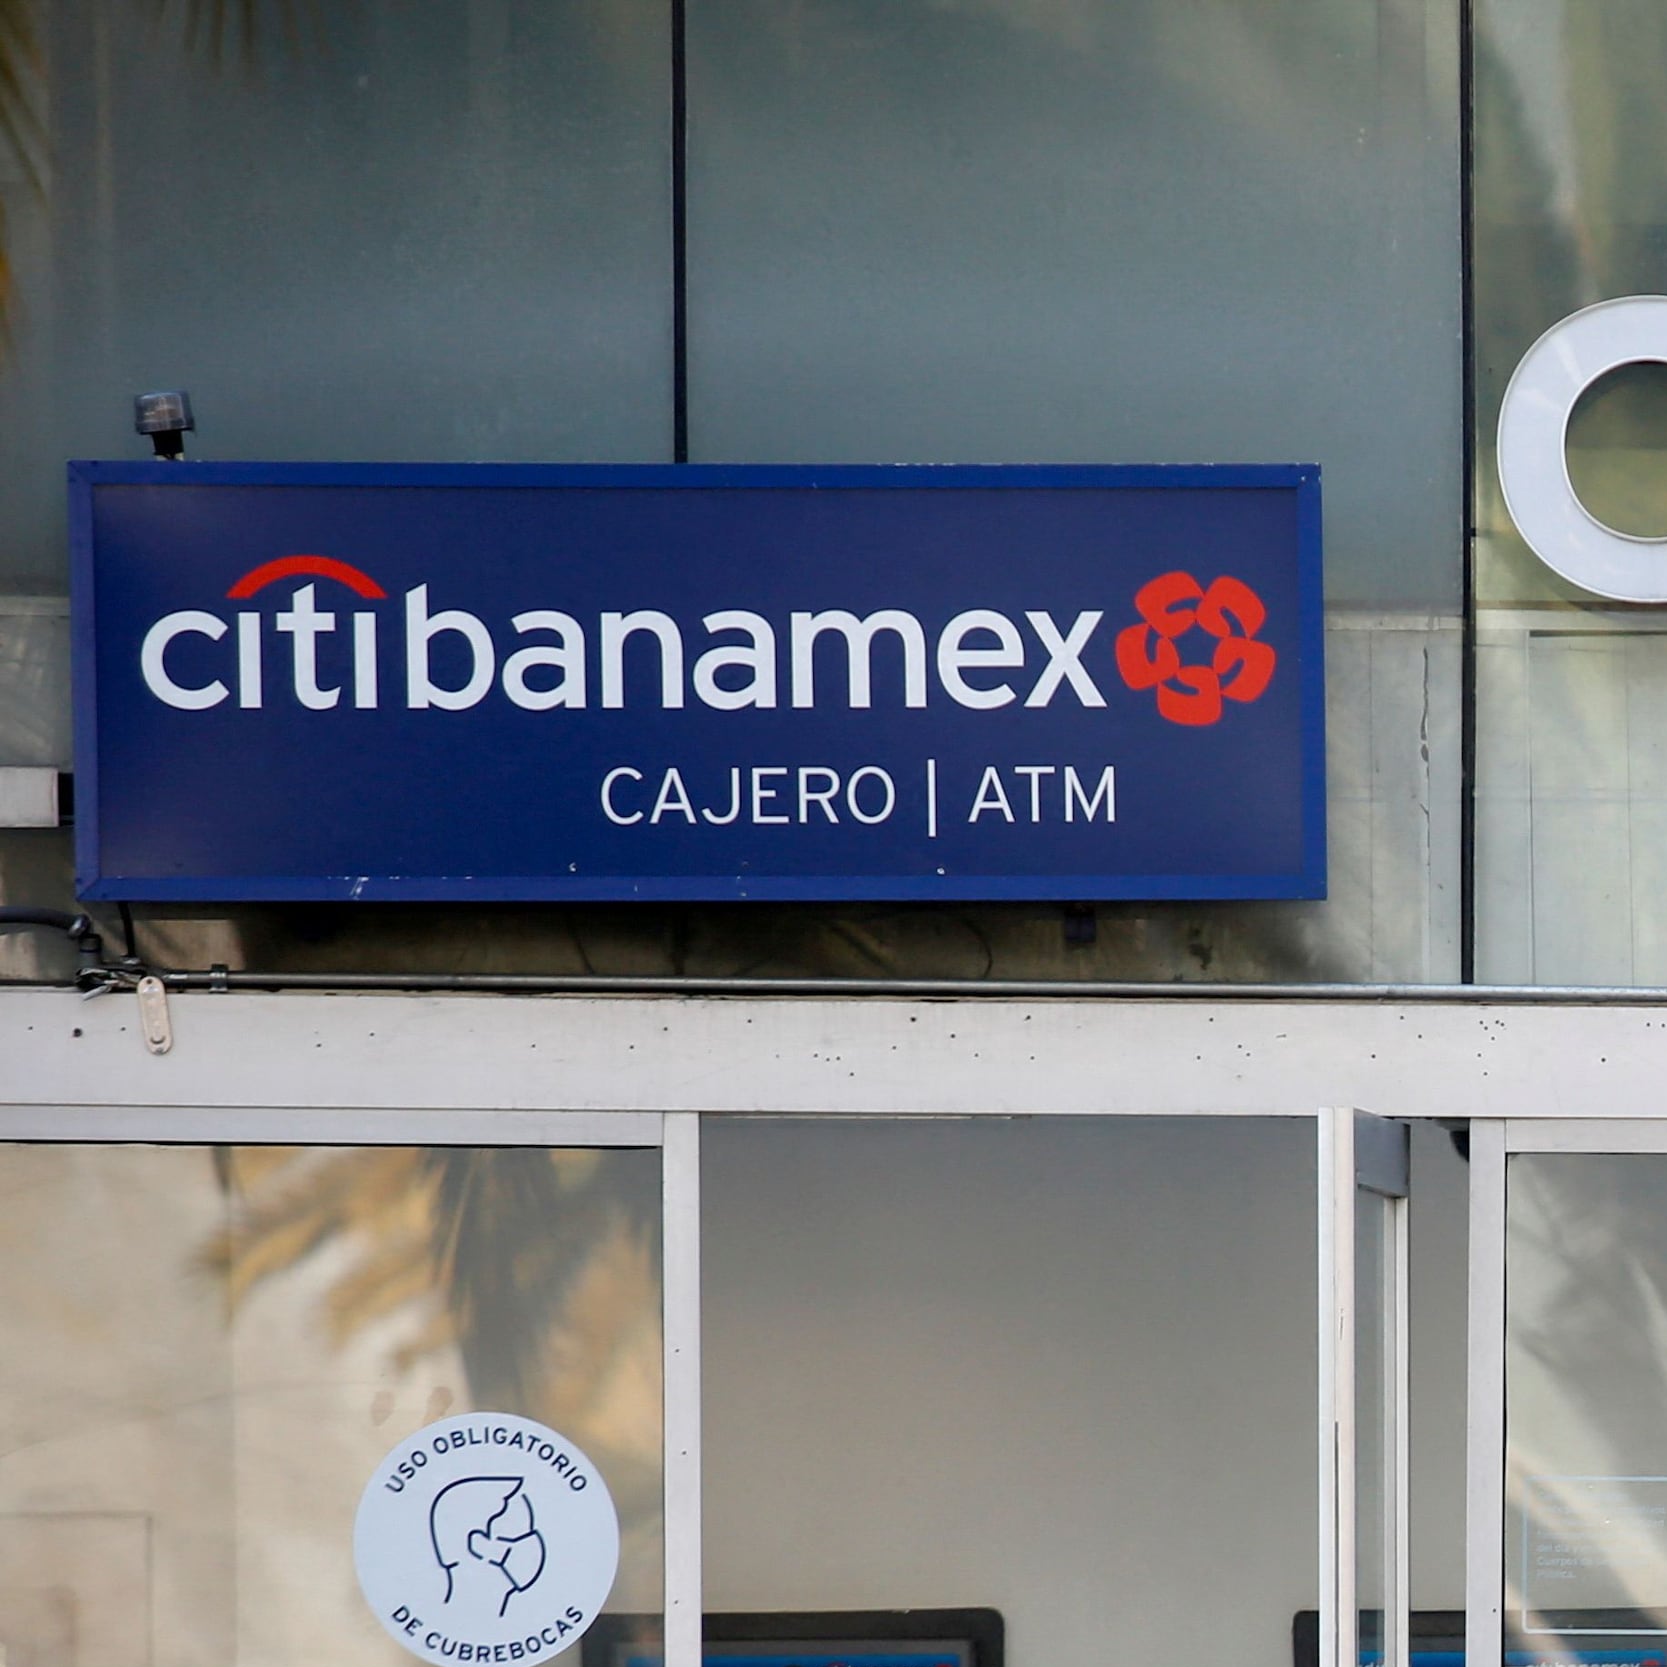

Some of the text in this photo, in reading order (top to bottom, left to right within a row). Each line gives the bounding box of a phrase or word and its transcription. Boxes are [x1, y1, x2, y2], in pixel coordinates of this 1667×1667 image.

[140, 582, 1108, 711] citibanamex
[601, 765, 1118, 827] CAJERO ATM
[385, 1426, 588, 1493] USO OBLIGATORIO
[391, 1605, 584, 1663] DE CUBREBOCAS
